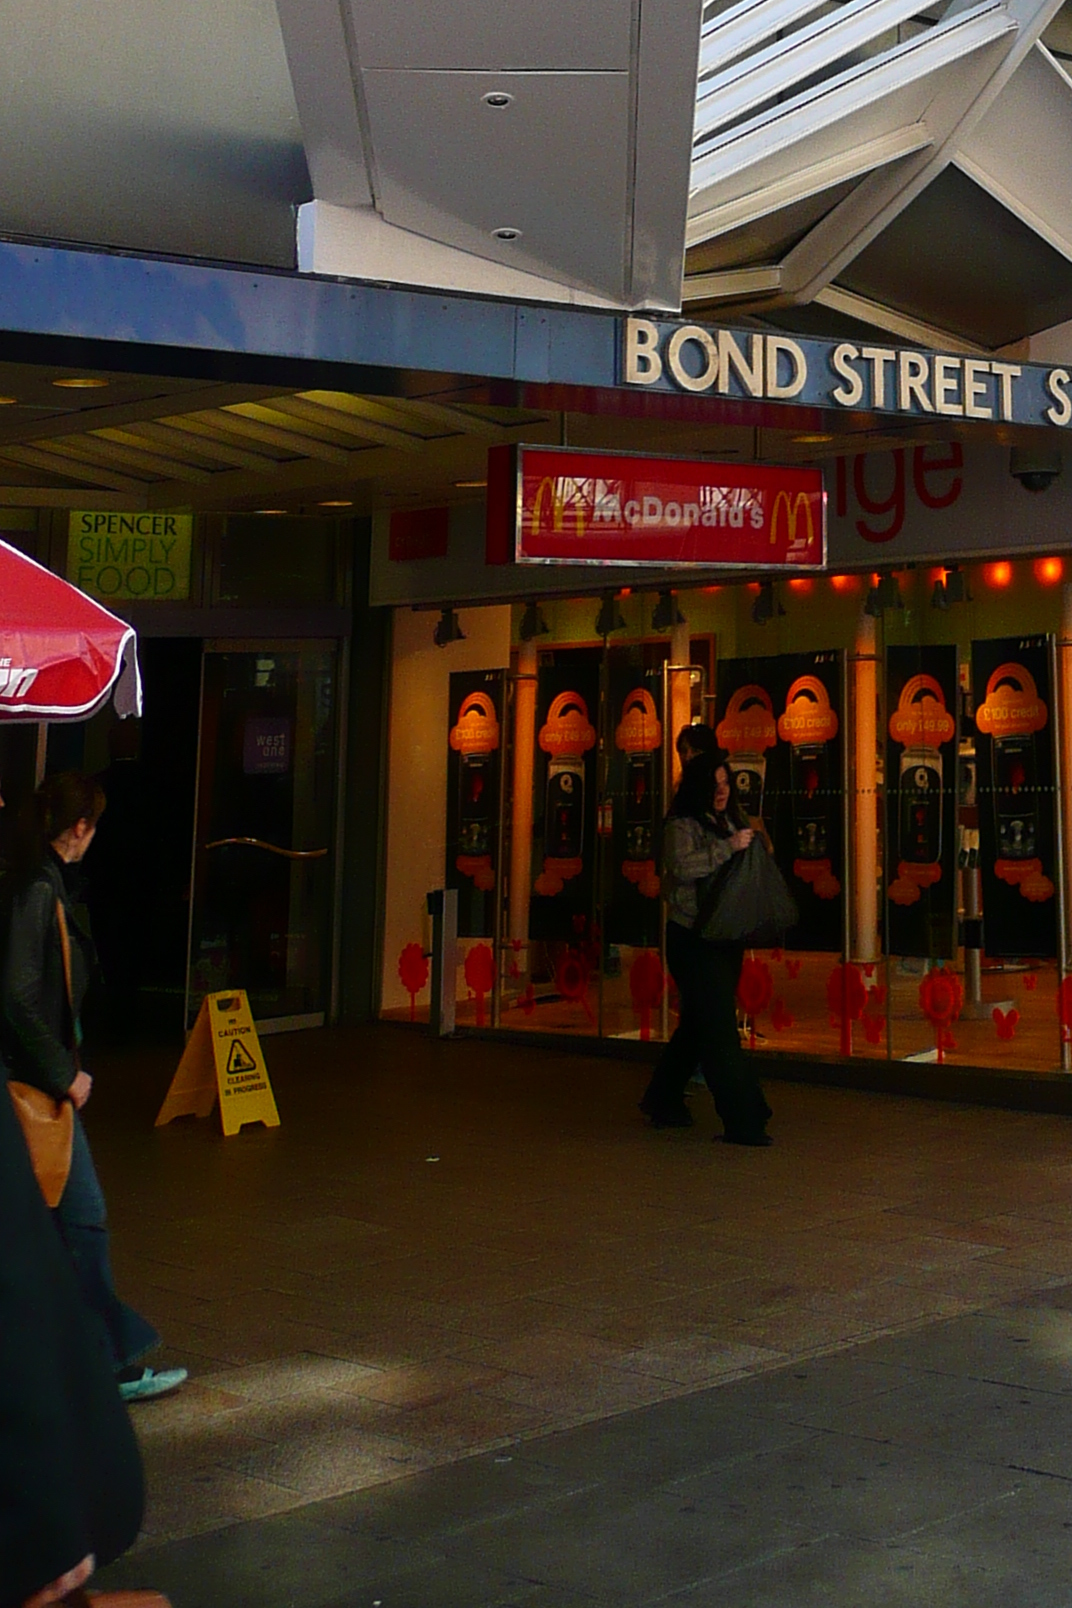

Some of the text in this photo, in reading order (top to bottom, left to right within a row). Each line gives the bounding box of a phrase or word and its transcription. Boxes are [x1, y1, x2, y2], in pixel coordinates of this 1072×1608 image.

[623, 317, 808, 399] BOND
[831, 343, 1022, 422] STREET
[81, 513, 177, 536] SPENCER
[592, 495, 765, 530] McDonald's
[79, 536, 177, 564] SIMPLY
[78, 565, 176, 596] FOOD
[218, 1026, 251, 1038] CAUTION
